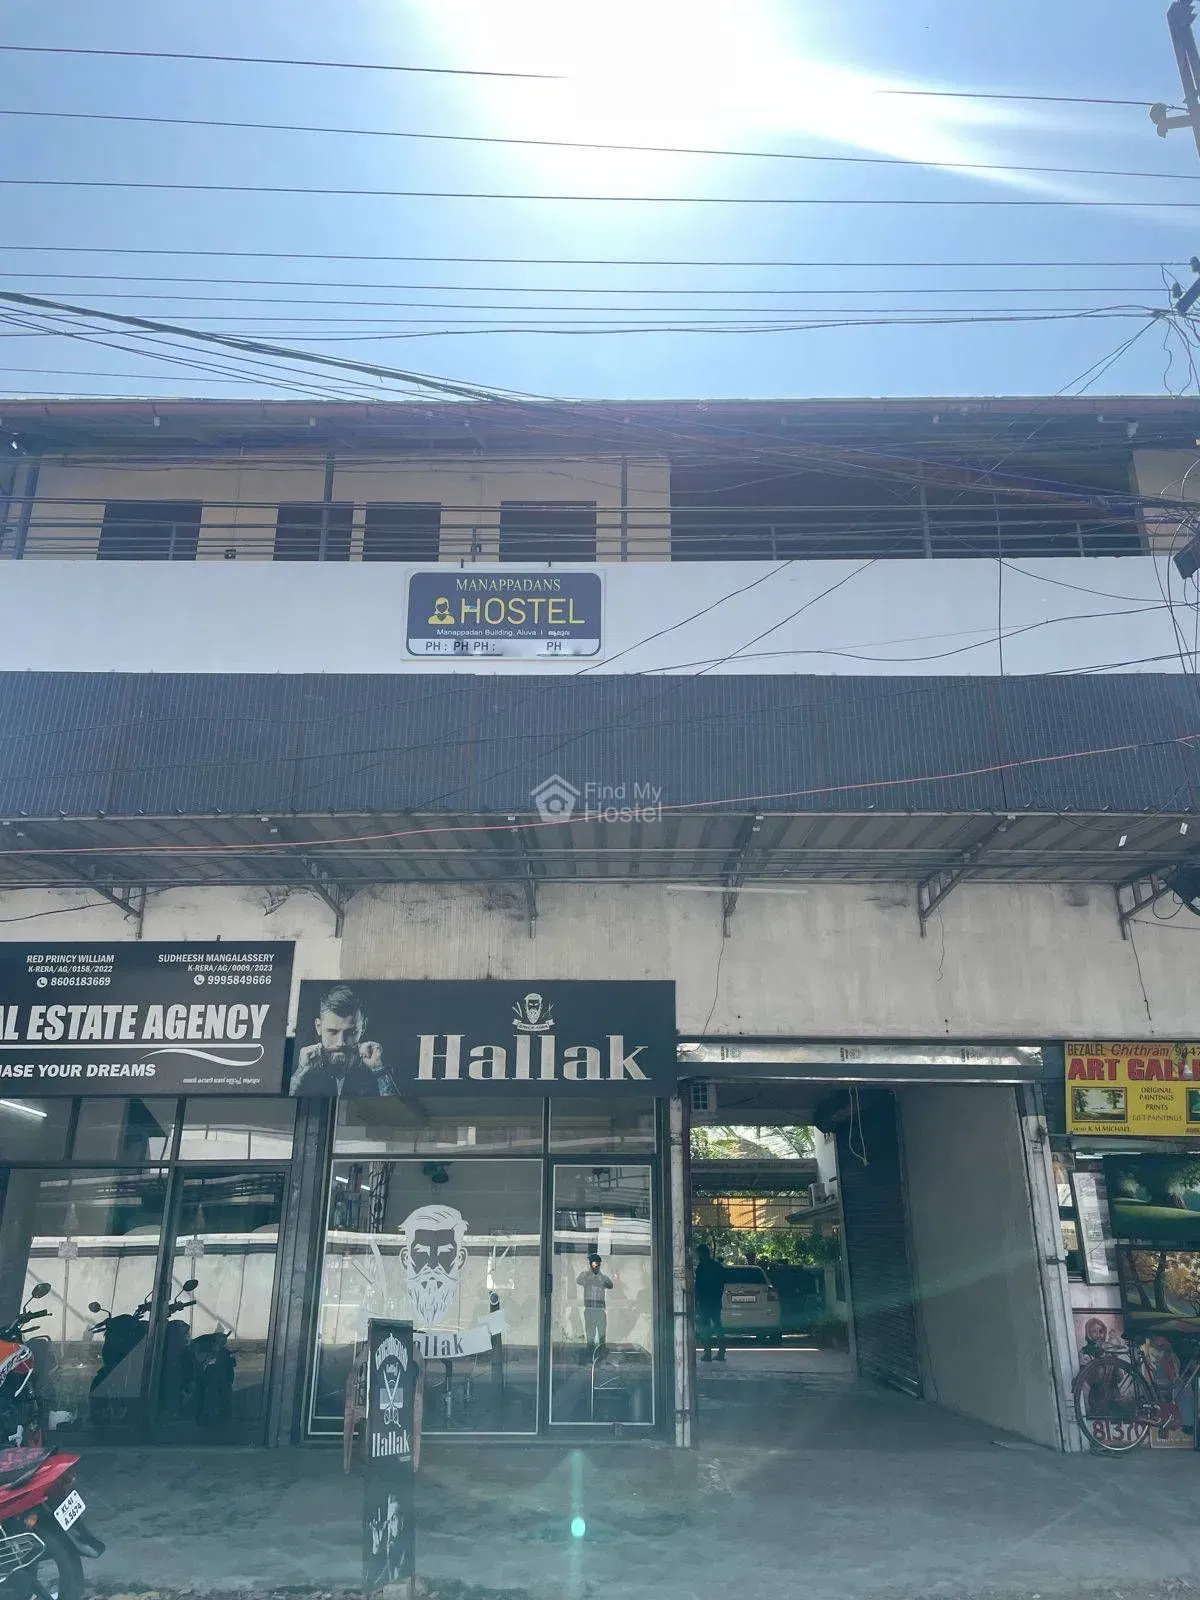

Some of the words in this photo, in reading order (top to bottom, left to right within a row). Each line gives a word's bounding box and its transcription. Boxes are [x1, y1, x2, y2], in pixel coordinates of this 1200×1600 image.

[456, 578, 561, 591] MANAPPADANS
[461, 598, 586, 624] HOSTEL
[436, 629, 483, 637] Manappadan
[453, 641, 469, 651] PH
[546, 641, 562, 651] PH
[26, 955, 44, 963] RED
[45, 955, 77, 963] PRINCY
[78, 955, 115, 963] WILLIAM
[158, 954, 204, 963] SUDHEESH
[205, 954, 275, 962] MANGALASSERY
[187, 964, 273, 972] K-RERA/AG/0009/2023
[207, 975, 272, 985] 9995849666
[0, 1005, 19, 1040] L
[26, 1005, 139, 1040] ESTATE
[141, 1004, 270, 1040] AGENCY
[1111, 1043, 1170, 1057] Chithram
[414, 1034, 652, 1081] Hallak
[0, 1064, 34, 1078] ASE
[38, 1064, 82, 1078] YOUR
[86, 1063, 156, 1077] DREAMS
[1068, 1058, 1121, 1080] ART
